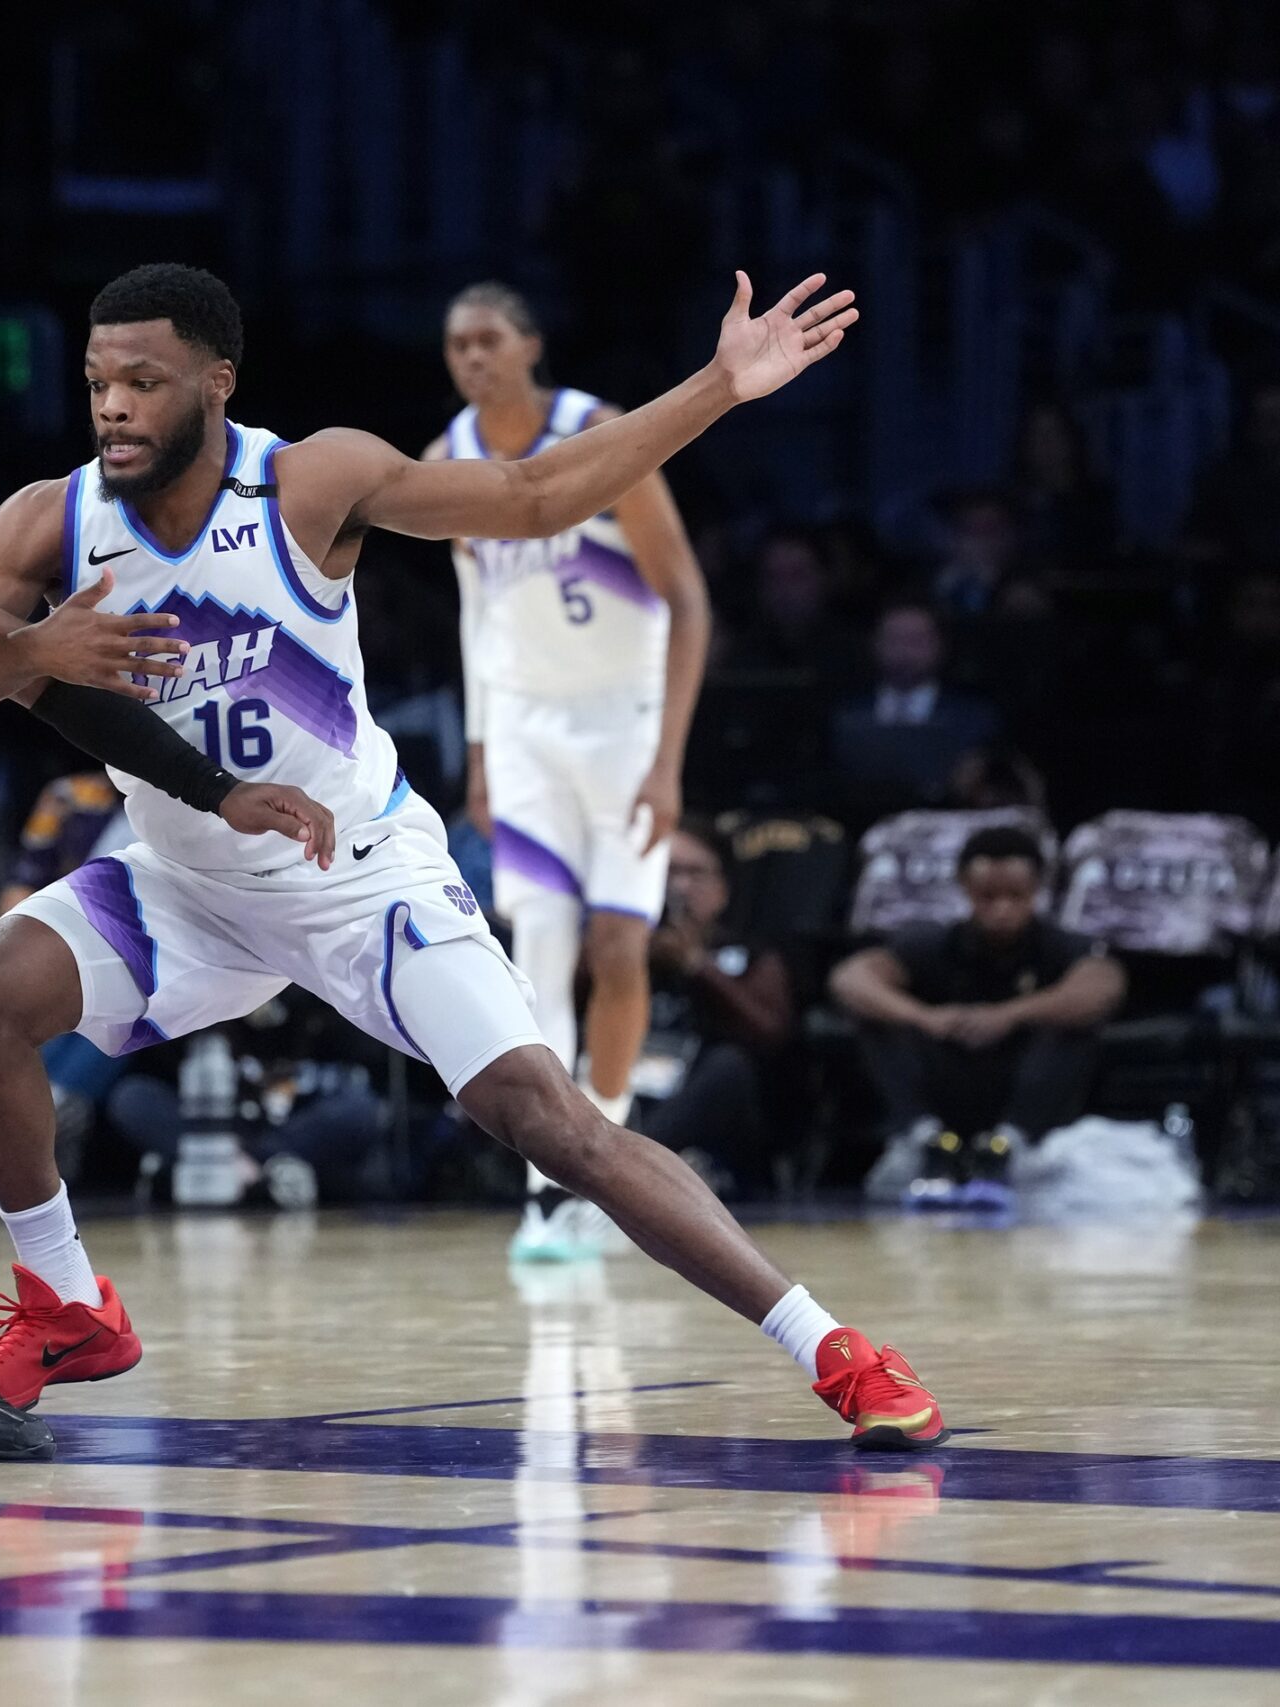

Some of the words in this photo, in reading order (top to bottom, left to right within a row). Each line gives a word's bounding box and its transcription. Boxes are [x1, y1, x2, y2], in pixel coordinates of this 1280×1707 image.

[211, 523, 259, 553] LVT
[560, 576, 595, 625] 5
[124, 622, 282, 707] TAH
[192, 697, 274, 769] 16
